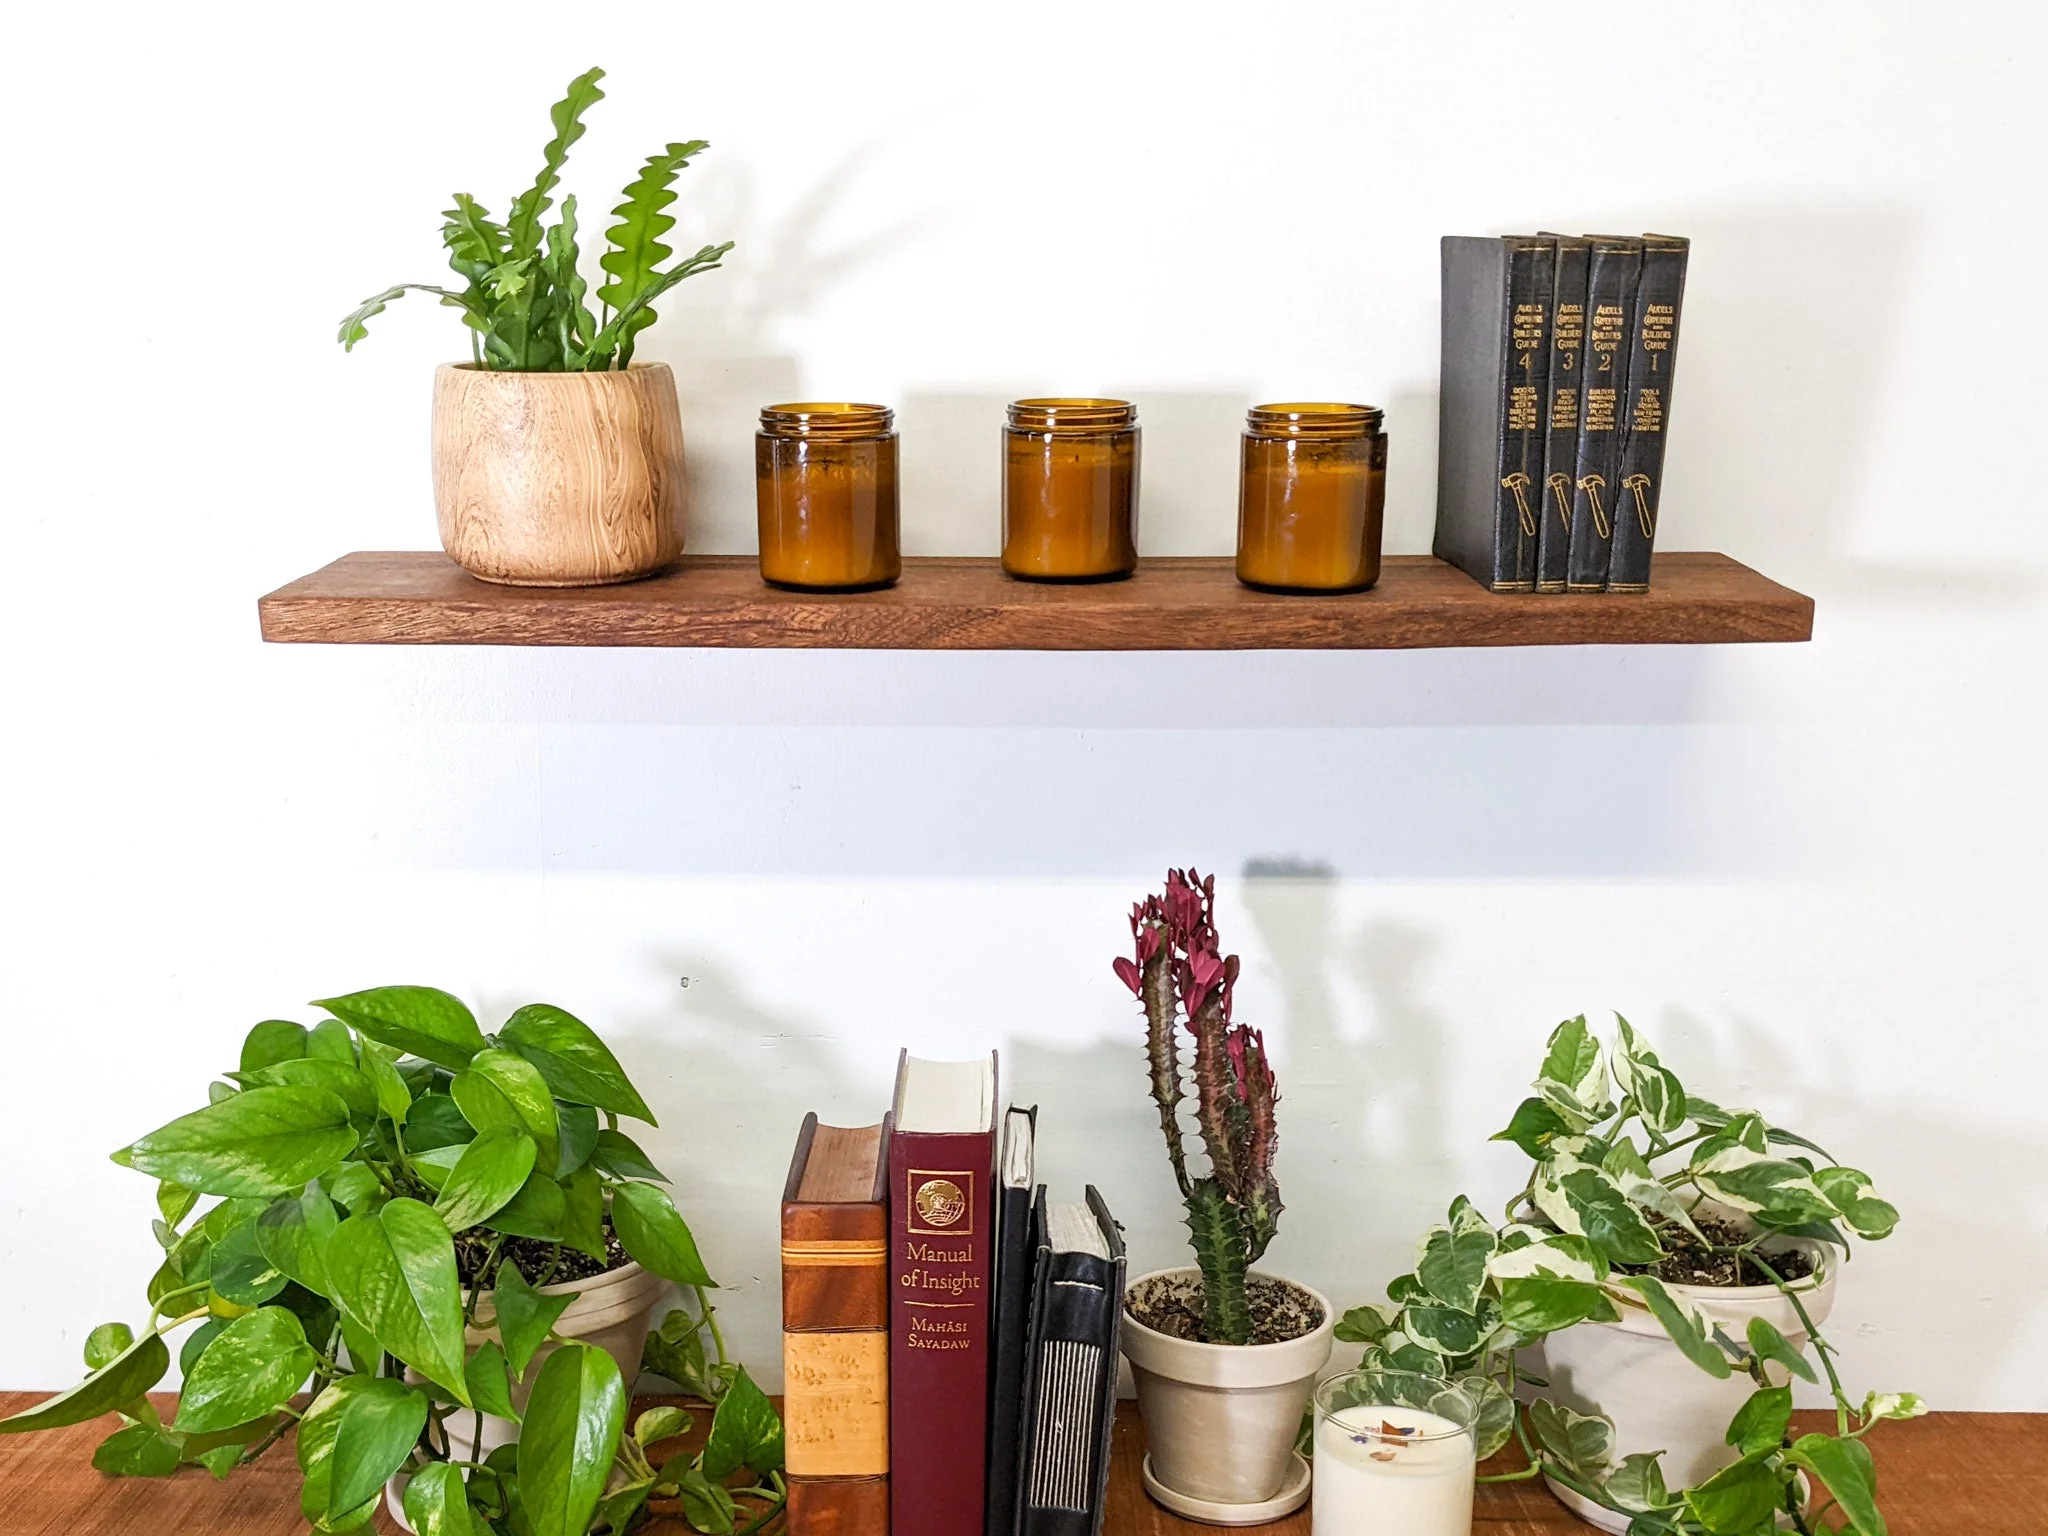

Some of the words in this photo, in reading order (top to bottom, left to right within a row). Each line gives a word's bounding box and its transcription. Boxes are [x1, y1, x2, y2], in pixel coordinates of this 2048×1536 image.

[1594, 341, 1618, 351] GUIDE
[1644, 340, 1667, 350] GUIDE
[1519, 352, 1532, 370] 4
[1563, 352, 1574, 370] 3
[1598, 353, 1611, 371] 2
[1652, 353, 1659, 371] 1
[907, 1242, 972, 1262] Manual
[901, 1269, 920, 1287] of
[922, 1270, 980, 1296] Insight
[908, 1333, 971, 1349] SAYADAW
